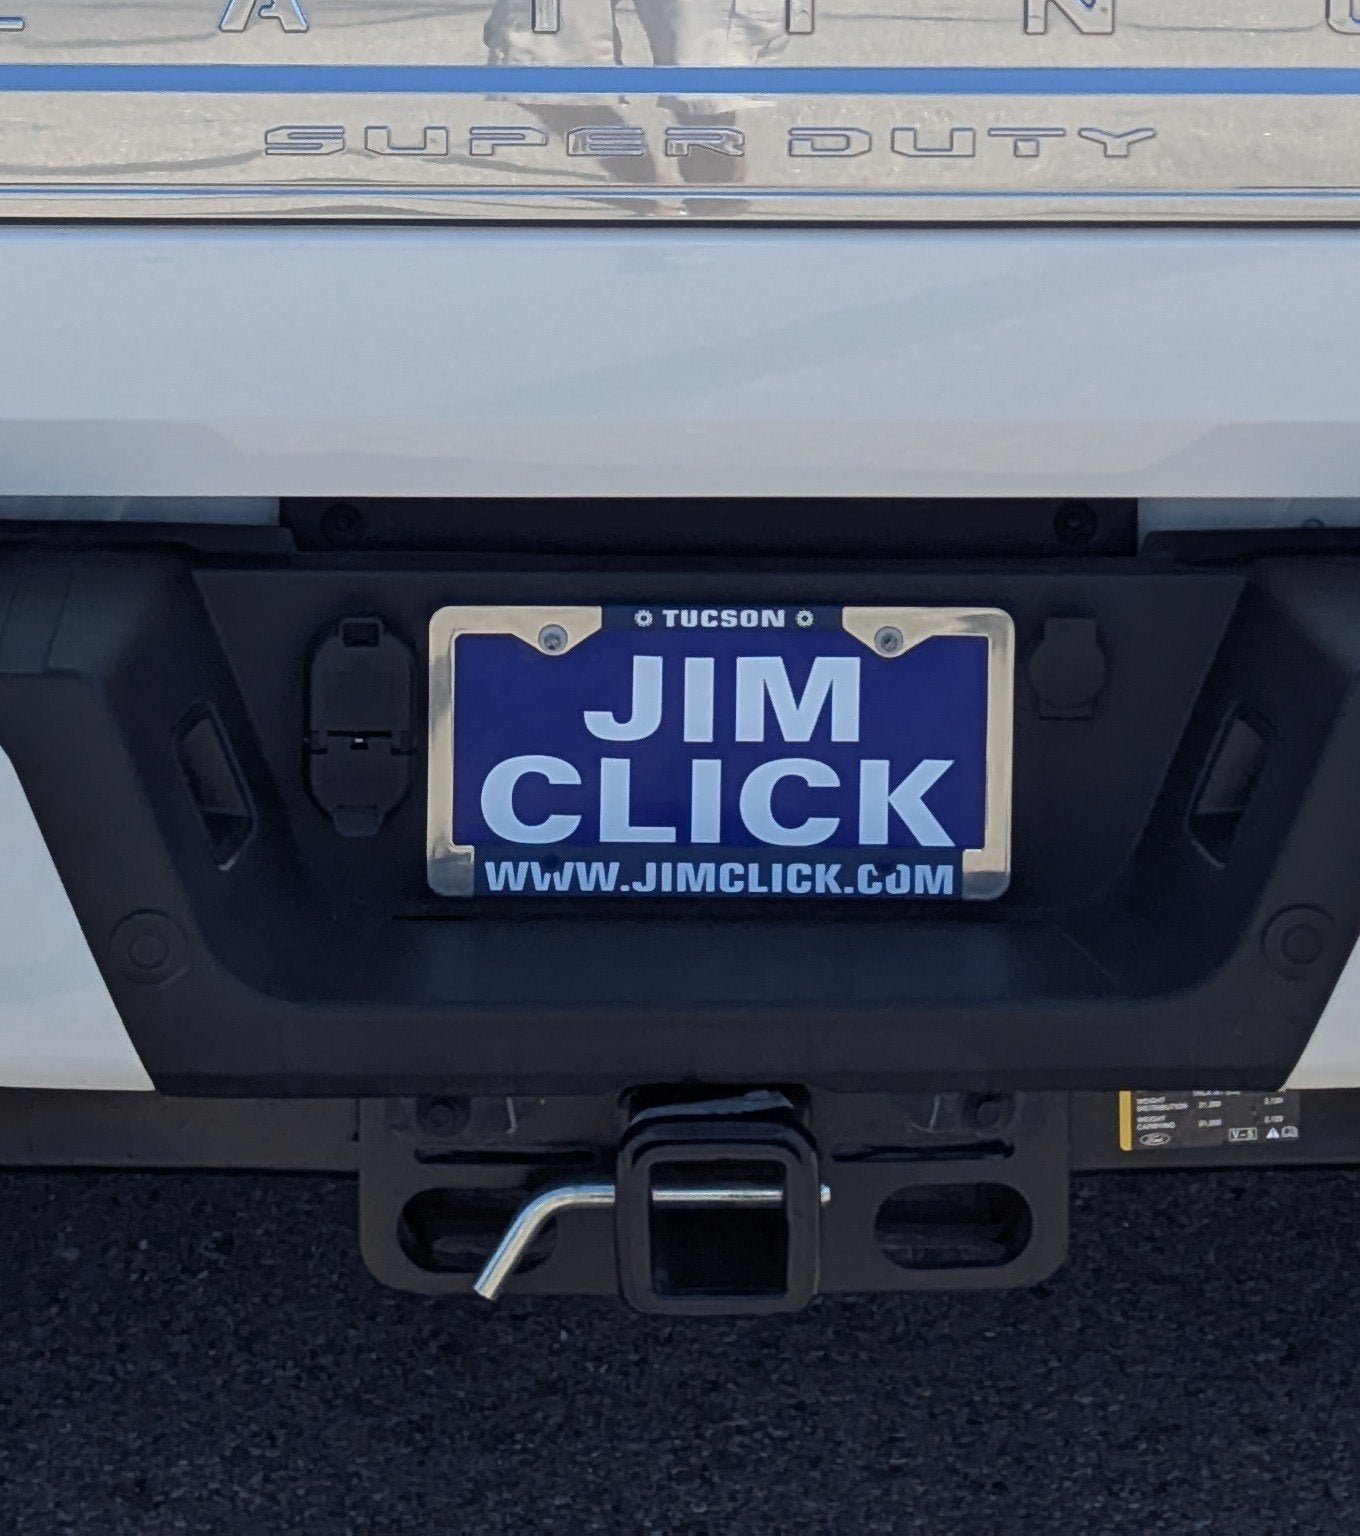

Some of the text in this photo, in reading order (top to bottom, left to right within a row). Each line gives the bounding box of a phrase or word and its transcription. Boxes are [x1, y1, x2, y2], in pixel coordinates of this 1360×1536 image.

[264, 124, 1157, 158] SUPER DUTY
[662, 609, 786, 627] TUCSON
[583, 655, 861, 743] JIM
[480, 755, 956, 847] CLICK
[485, 861, 954, 895] WWW.JIMCLICK.COM
